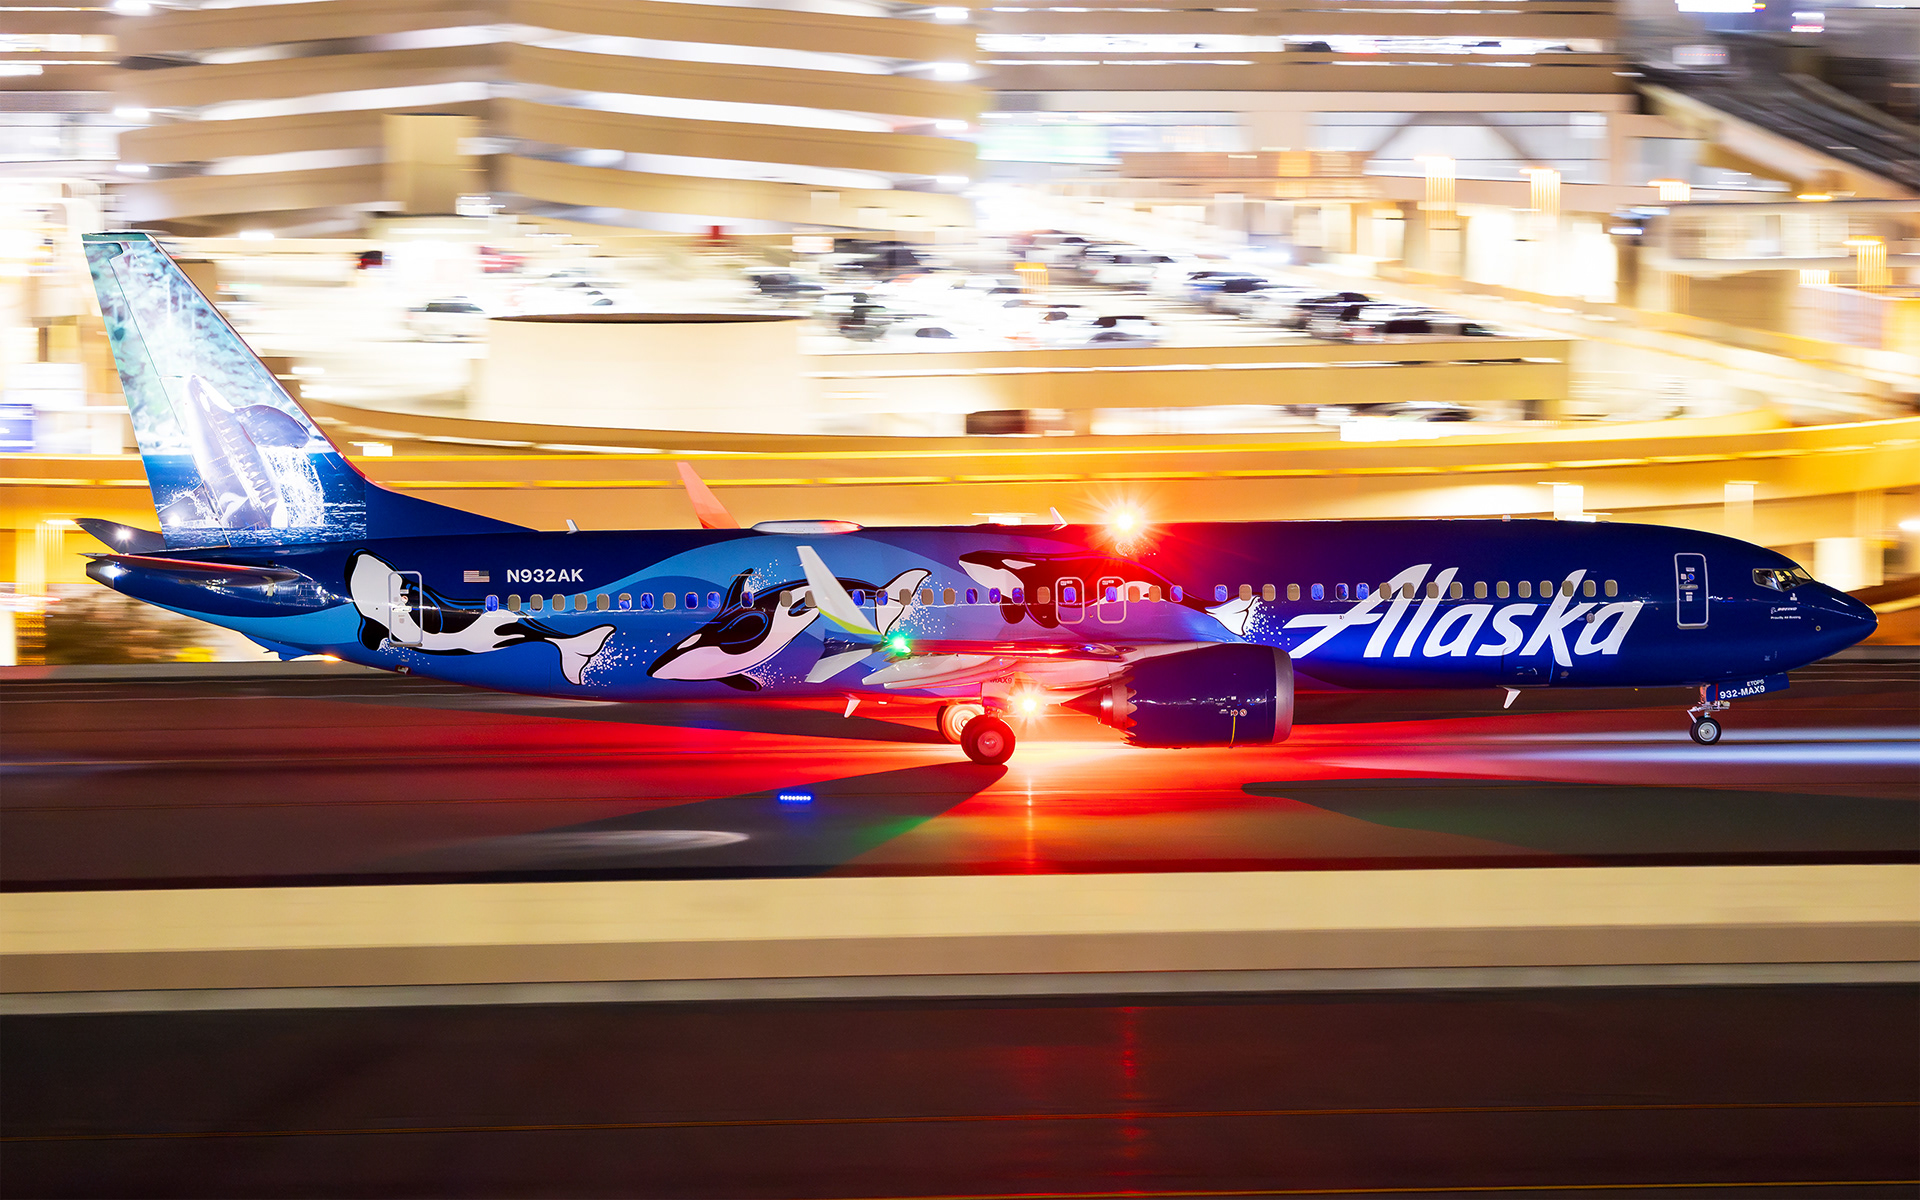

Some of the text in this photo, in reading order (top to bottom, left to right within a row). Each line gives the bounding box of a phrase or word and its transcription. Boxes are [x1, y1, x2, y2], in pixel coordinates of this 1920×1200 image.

[506, 568, 584, 583] N932AK
[1283, 563, 1644, 667] Alaska
[1746, 679, 1765, 687] ETOPS
[1719, 685, 1766, 699] 932-MAX9
